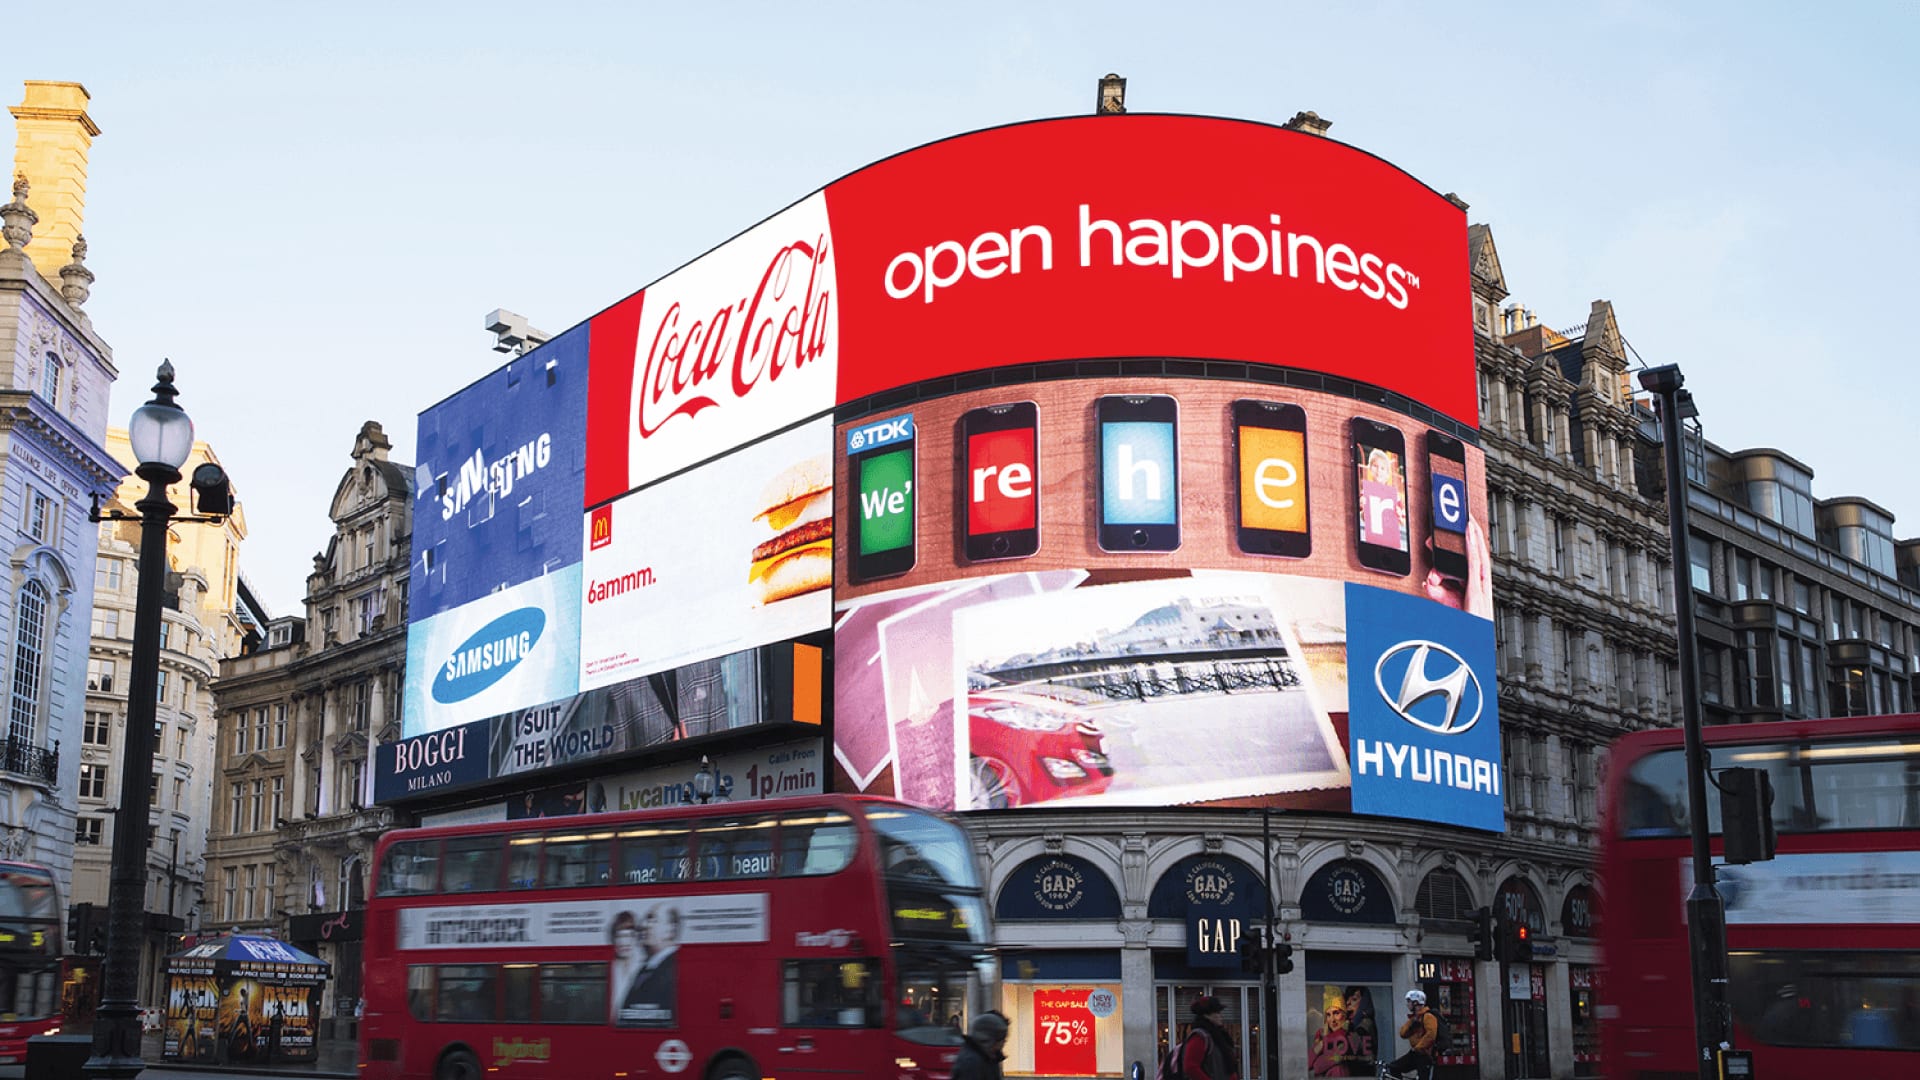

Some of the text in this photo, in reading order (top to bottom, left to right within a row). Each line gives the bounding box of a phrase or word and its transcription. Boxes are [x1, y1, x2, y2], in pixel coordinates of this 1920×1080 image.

[884, 204, 1409, 310] open happiness
[865, 418, 909, 445] TDK
[44, 466, 56, 484] LIFE
[61, 479, 79, 500] OFFICE
[973, 461, 1032, 503] re
[1118, 444, 1161, 501] h
[1254, 458, 1297, 509] e
[1369, 495, 1395, 535] r
[1439, 483, 1460, 523] e
[588, 567, 657, 604] 6ammm.
[445, 630, 531, 682] SAMSUNG
[515, 705, 561, 737] I SUIT
[393, 727, 466, 774] BOGGI
[515, 724, 615, 767] THE WORLD
[768, 749, 816, 765] Calls From
[1357, 739, 1499, 796] HYUNDAI
[408, 770, 452, 792] MILANO
[1042, 875, 1076, 894] GAP
[1194, 874, 1228, 894] GAP
[1334, 879, 1361, 898] GAP
[1049, 892, 1069, 900] 1969
[1201, 892, 1221, 900] 1969
[1198, 918, 1241, 953] GAP
[1418, 963, 1436, 979] GAP
[1040, 1000, 1054, 1009] THE
[1055, 1000, 1070, 1009] GAP
[1093, 994, 1112, 1002] NEW
[1051, 1014, 1060, 1022] TO
[1072, 1036, 1088, 1046] OFF
